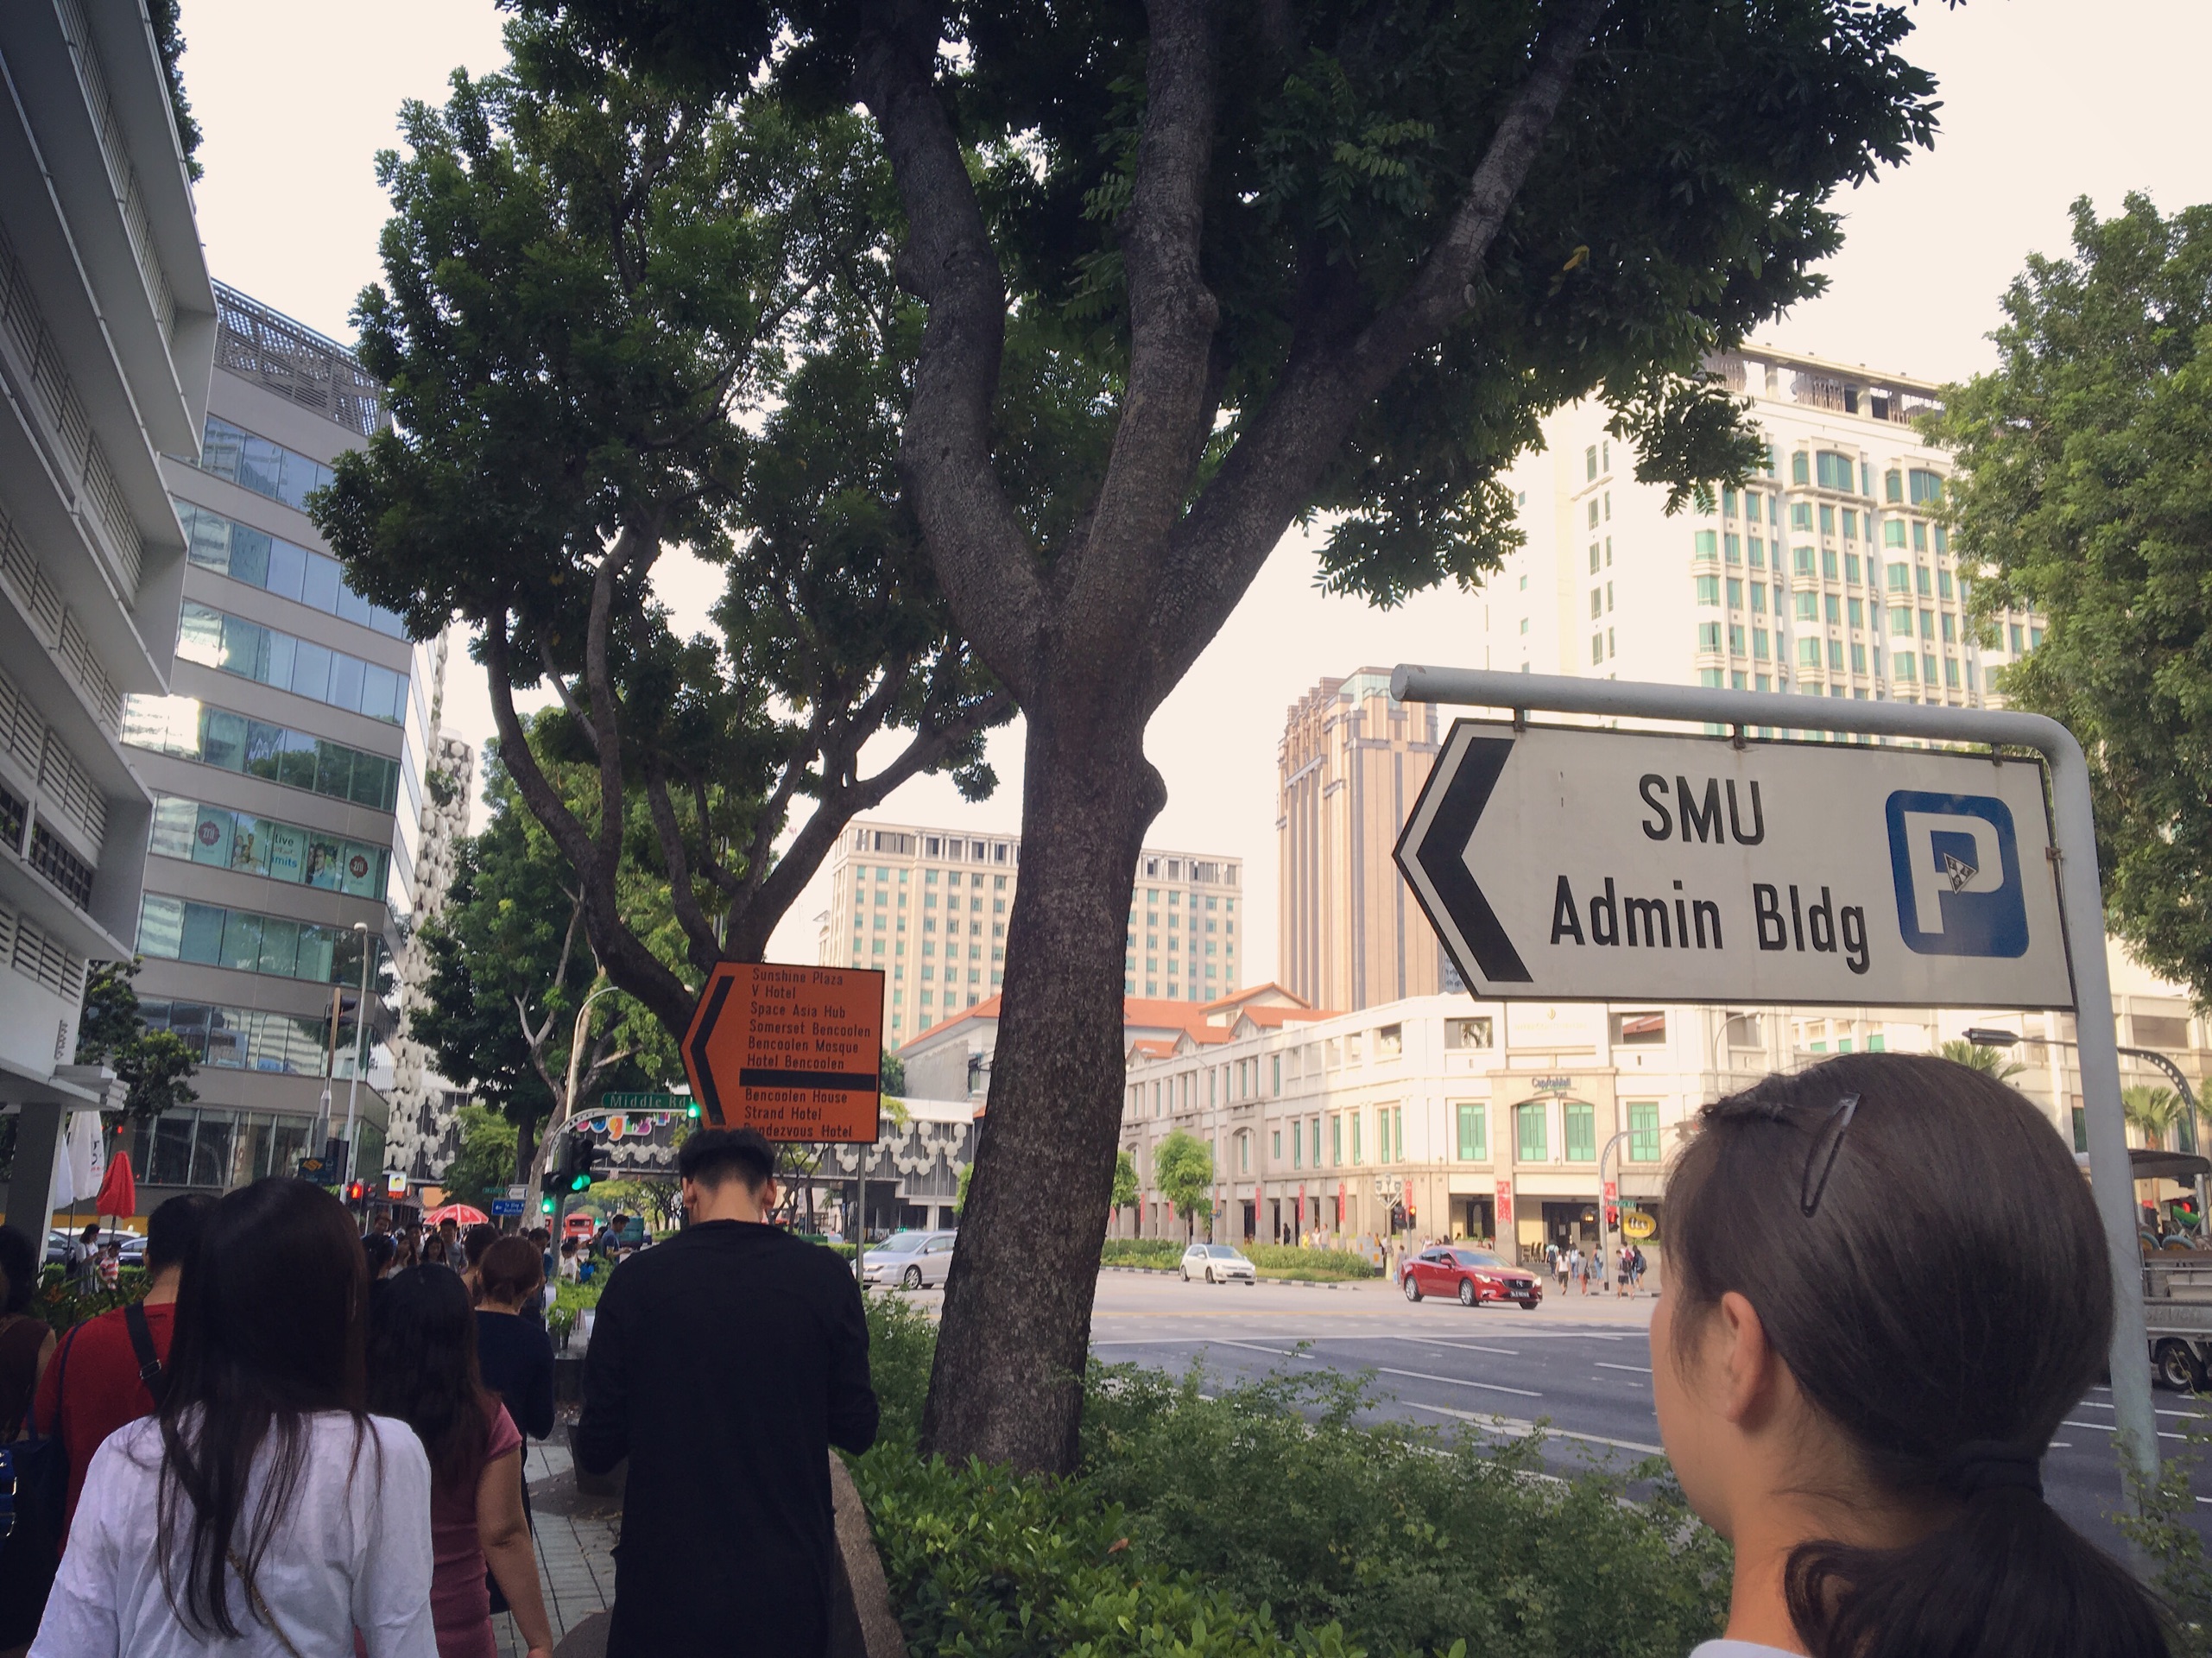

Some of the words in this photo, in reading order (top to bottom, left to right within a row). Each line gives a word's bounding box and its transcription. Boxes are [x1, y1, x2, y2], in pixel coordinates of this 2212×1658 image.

[1639, 773, 1766, 846] SMU
[1550, 875, 1723, 949] Admin
[1754, 883, 1871, 975] Bldg
[753, 968, 806, 984] Sunshine
[812, 971, 844, 985] Plaza
[751, 984, 760, 997] V
[765, 985, 796, 1000] Hotel
[750, 1002, 786, 1018] Space
[793, 1004, 818, 1018] Asia
[824, 1005, 846, 1019] Hub
[749, 1019, 806, 1035] Somerset
[812, 1022, 871, 1038] Bencoolen
[748, 1036, 809, 1052] Bencoolen
[815, 1040, 859, 1057] Mosque
[747, 1054, 778, 1068] Hotel
[785, 1055, 844, 1071] Bencoolen
[610, 1095, 662, 1108] Middle
[668, 1095, 687, 1108] Rd
[745, 1088, 806, 1103] Bencoolen
[812, 1090, 848, 1104] House
[744, 1106, 785, 1120] Strand
[791, 1107, 822, 1121] Hotel
[743, 1123, 813, 1137] ndezvous
[821, 1124, 852, 1138] Hotel
